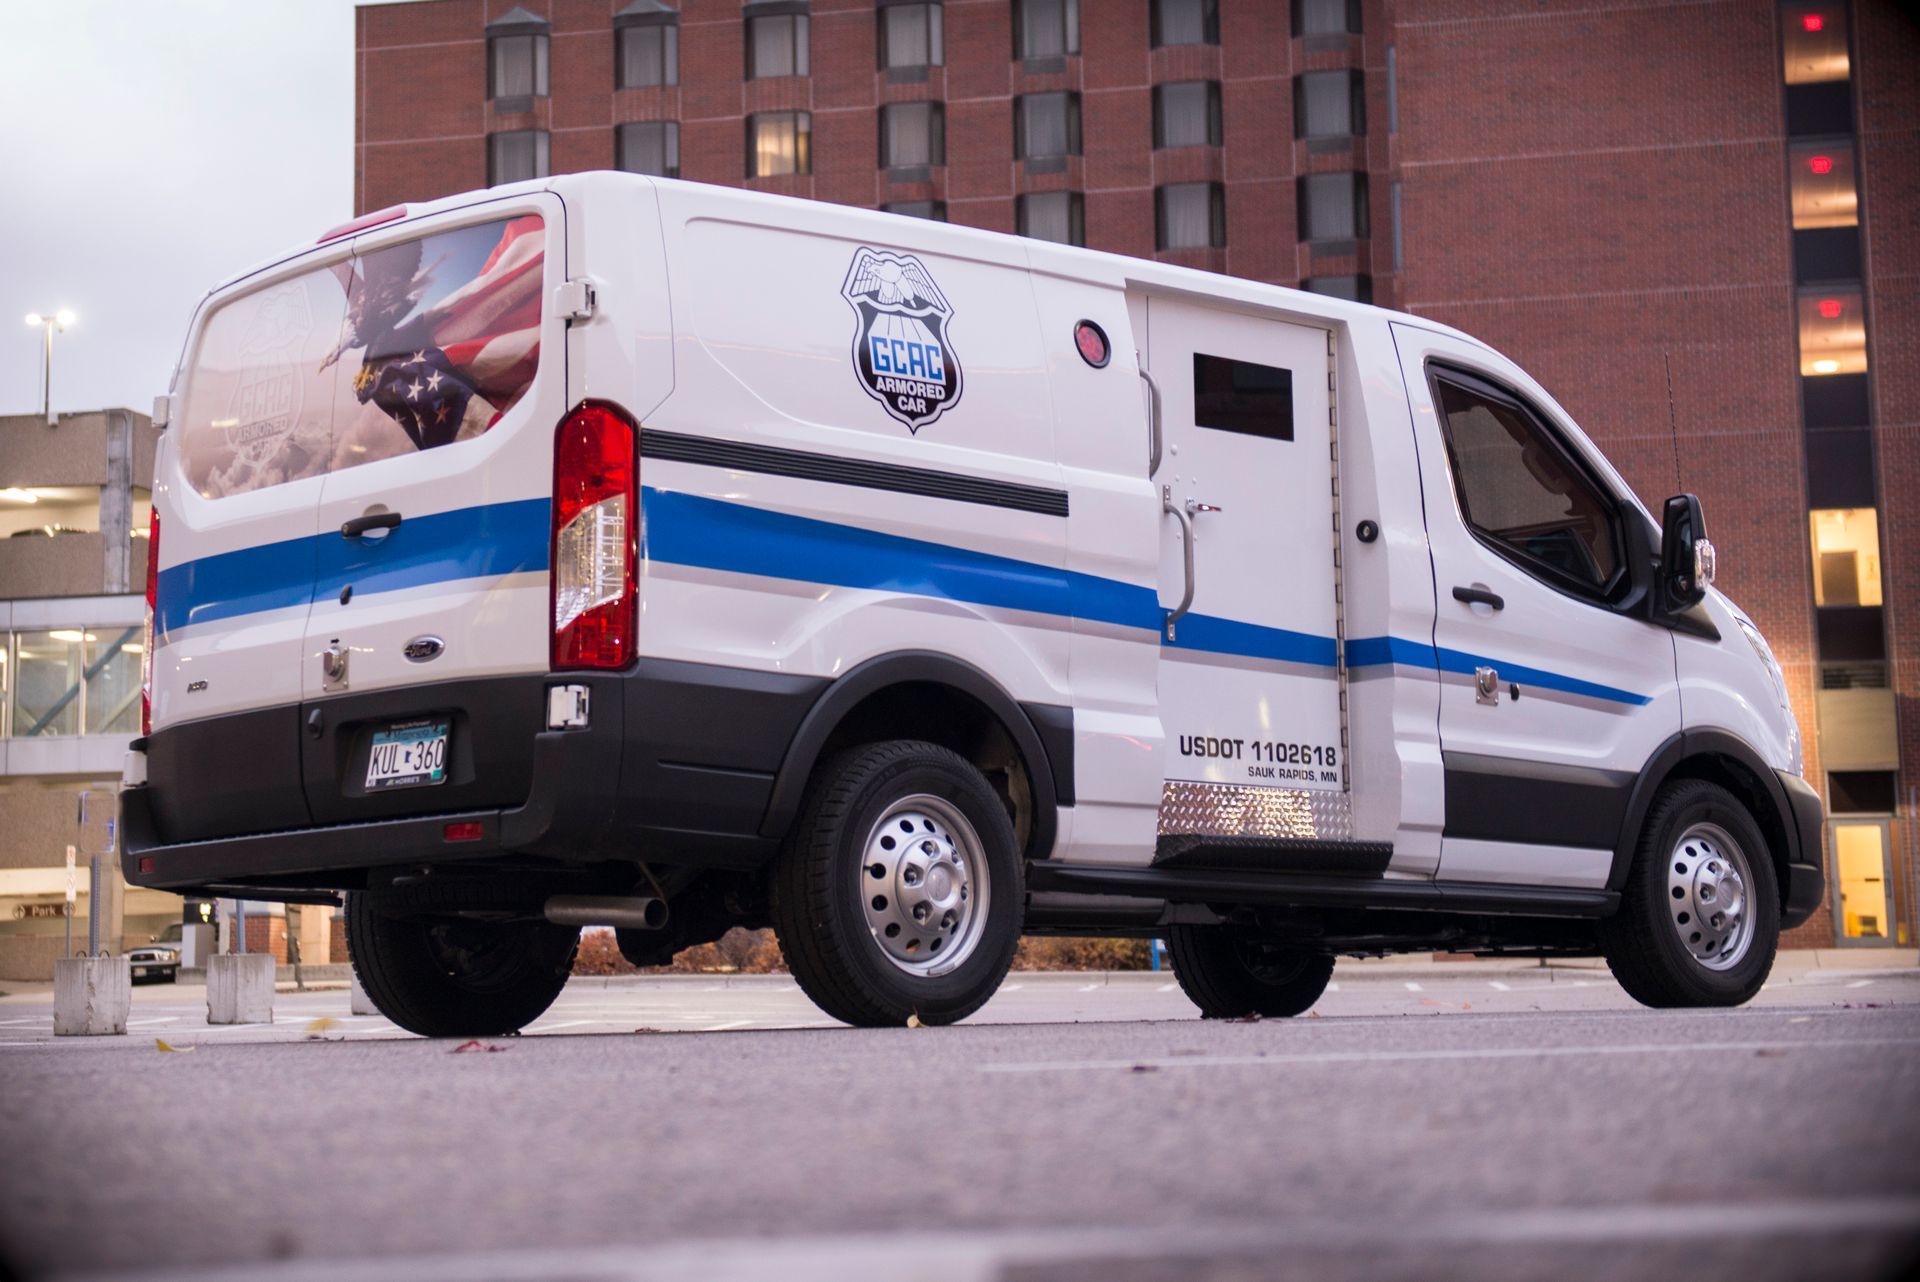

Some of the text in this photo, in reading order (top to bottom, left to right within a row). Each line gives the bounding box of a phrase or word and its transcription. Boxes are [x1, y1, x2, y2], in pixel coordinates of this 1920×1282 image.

[871, 336, 943, 380] GCAC
[876, 376, 945, 400] ARMORED
[897, 397, 927, 413] CAR
[238, 416, 288, 442] ARMORED
[370, 738, 445, 776] KUL 360
[1180, 735, 1337, 766] USDOT 1102618
[1248, 766, 1337, 783] SAUK RAPIDS, MN
[32, 904, 56, 916] Park
